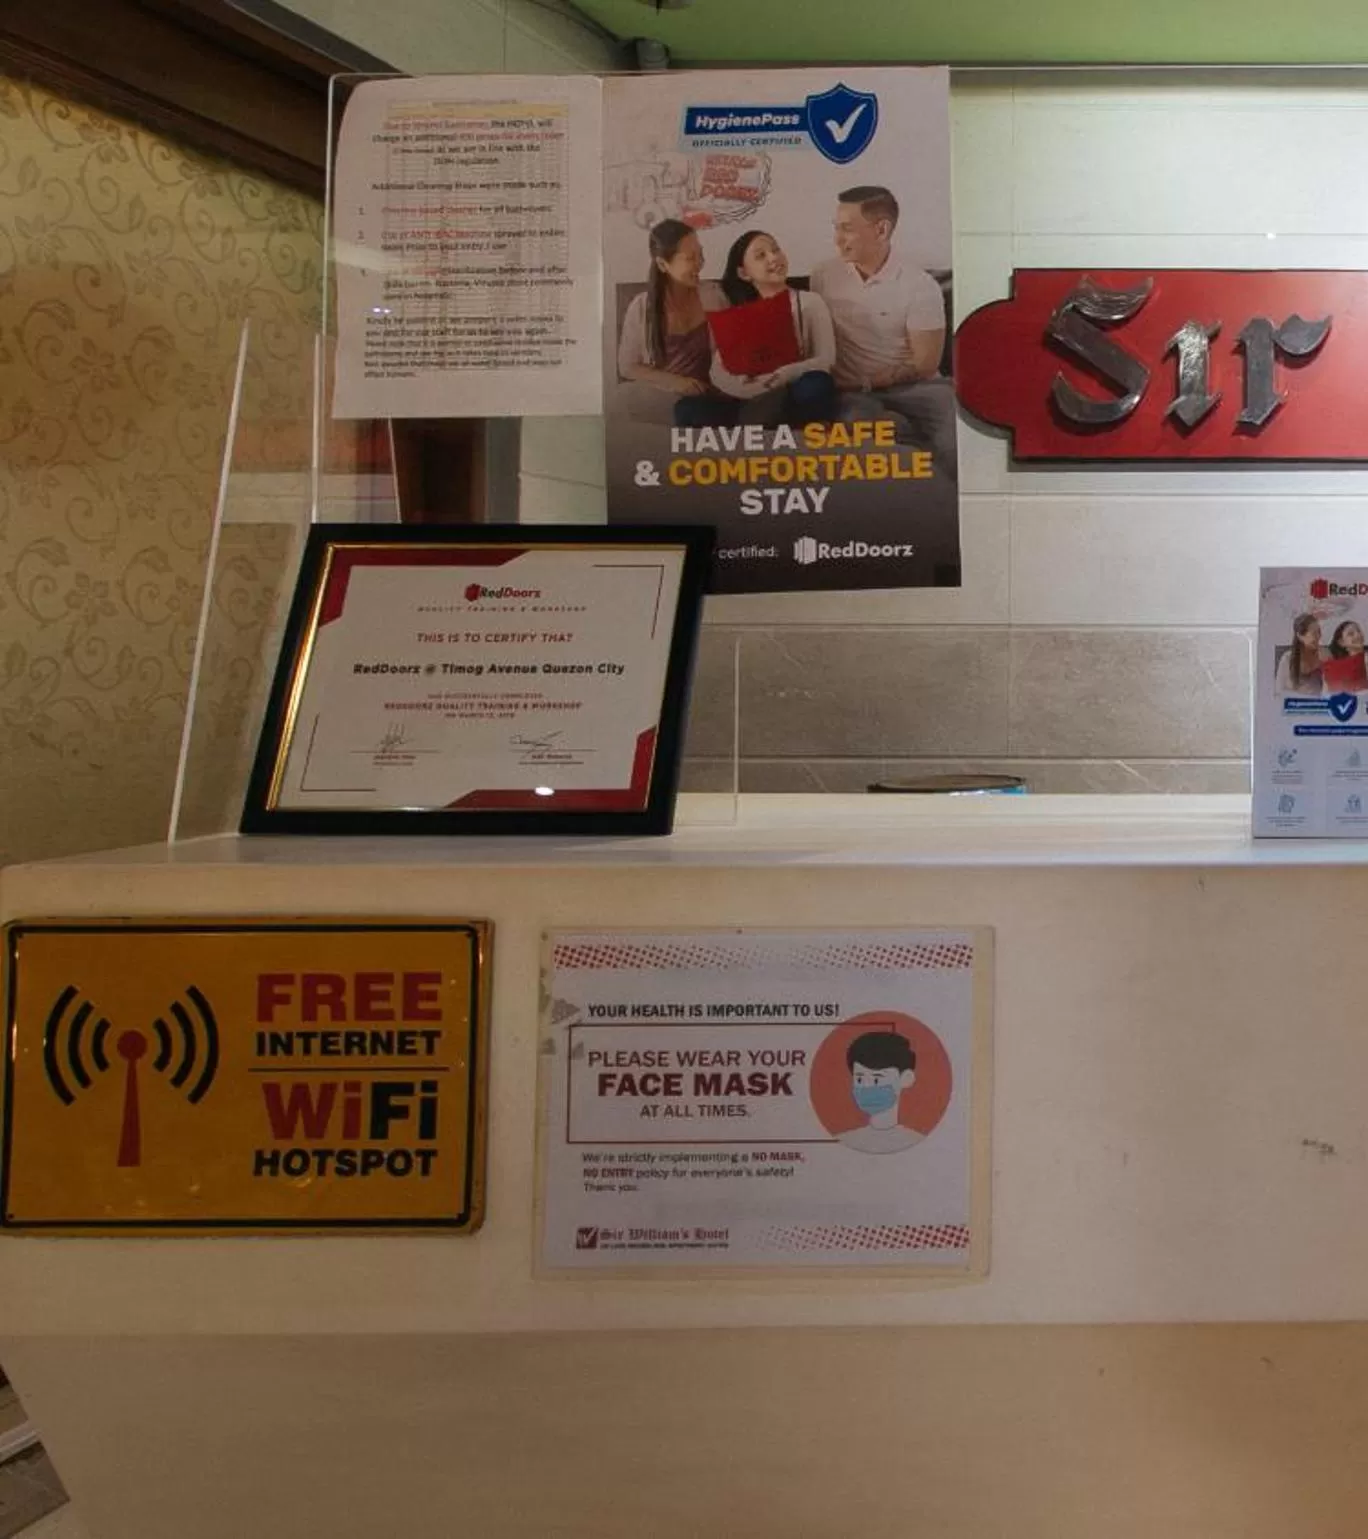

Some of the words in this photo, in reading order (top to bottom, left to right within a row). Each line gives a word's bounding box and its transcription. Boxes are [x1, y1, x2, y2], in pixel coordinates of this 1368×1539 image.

[693, 112, 800, 131] HygienePass
[1043, 275, 1332, 428] Sir
[670, 425, 763, 453] HAVE
[772, 424, 797, 450] A
[802, 421, 896, 448] SAFE
[634, 460, 660, 486] &
[668, 451, 934, 485] COMFORTABLE
[740, 487, 831, 515] STAY
[817, 541, 914, 559] RedDoorz
[479, 586, 542, 599] RedDoorz
[416, 633, 444, 643] THIS
[448, 633, 460, 643] IS
[464, 633, 481, 643] TO
[484, 633, 538, 643] CERTIFY
[541, 633, 574, 643] THAT
[352, 663, 422, 675] RedDoorz
[441, 663, 484, 677] Timog
[486, 663, 538, 675] Avenue
[541, 663, 593, 676] Quezon
[597, 663, 625, 677] City
[435, 702, 475, 710] QUALITY
[477, 702, 519, 710] TRAINING
[531, 702, 582, 710] WORKSHOP
[256, 972, 443, 1023] FREE
[588, 1005, 627, 1018] YOUR
[631, 1005, 685, 1017] HEALTH
[688, 1004, 703, 1017] IS
[706, 1004, 792, 1017] IMPORTANT
[793, 1003, 810, 1017] TO
[814, 1003, 840, 1017] US!
[255, 1030, 442, 1057] INTERNET
[588, 1051, 670, 1068] PLEASE
[675, 1050, 742, 1068] WEAR
[744, 1050, 806, 1067] YOUR
[598, 1072, 684, 1097] FACE
[693, 1072, 794, 1097] MASK
[262, 1080, 438, 1141] WiFi
[640, 1104, 659, 1118] AT
[663, 1104, 694, 1118] ALL
[698, 1103, 751, 1118] TIMES.
[253, 1149, 438, 1178] HOTSPOT
[582, 1152, 616, 1163] We're
[617, 1152, 657, 1164] strictly
[659, 1152, 738, 1164] implementing
[751, 1151, 767, 1162] NO
[769, 1151, 806, 1163] MASK,
[583, 1168, 598, 1178] NO
[601, 1168, 635, 1178] ENTRY
[636, 1168, 669, 1180] policy
[671, 1167, 688, 1177] for
[690, 1167, 752, 1179] everyone's
[755, 1167, 794, 1179] safety!
[583, 1182, 616, 1192] Thank
[599, 1228, 624, 1240] Sir
[627, 1227, 689, 1241] William's
